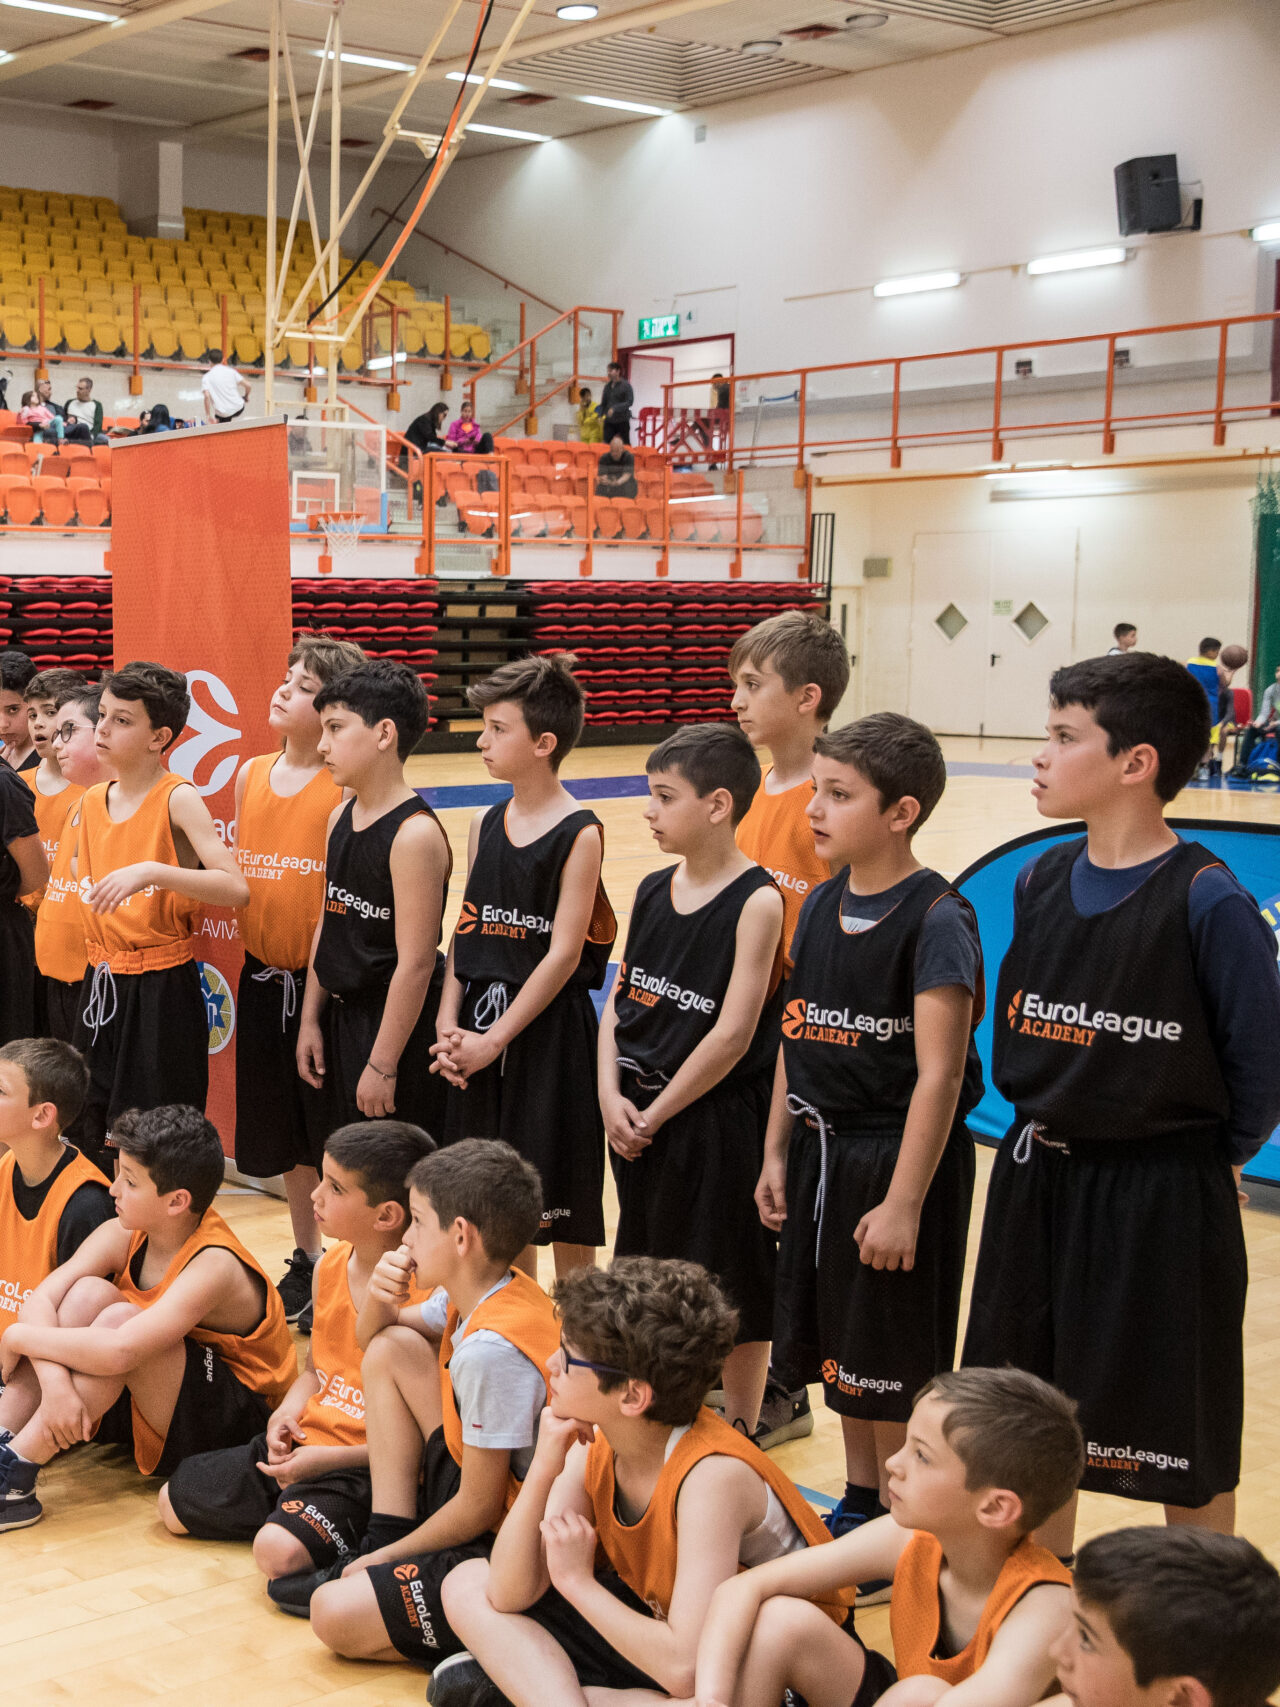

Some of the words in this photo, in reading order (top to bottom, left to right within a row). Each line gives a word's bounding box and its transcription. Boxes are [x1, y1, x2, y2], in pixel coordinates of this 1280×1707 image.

[243, 867, 284, 880] ACADEMY
[806, 1002, 914, 1041] EuroLeague
[1019, 1018, 1097, 1047] ACADEMY
[1022, 993, 1182, 1043] EuroLeague
[804, 1025, 861, 1047] ACADEMY
[203, 1347, 213, 1382] eague
[1087, 1441, 1189, 1470] EuroLeague
[1087, 1457, 1140, 1472] ACADEMY
[299, 1512, 332, 1544] ACADEMY
[304, 1504, 350, 1556] EuroLeag
[400, 1584, 420, 1628] ACADEMY
